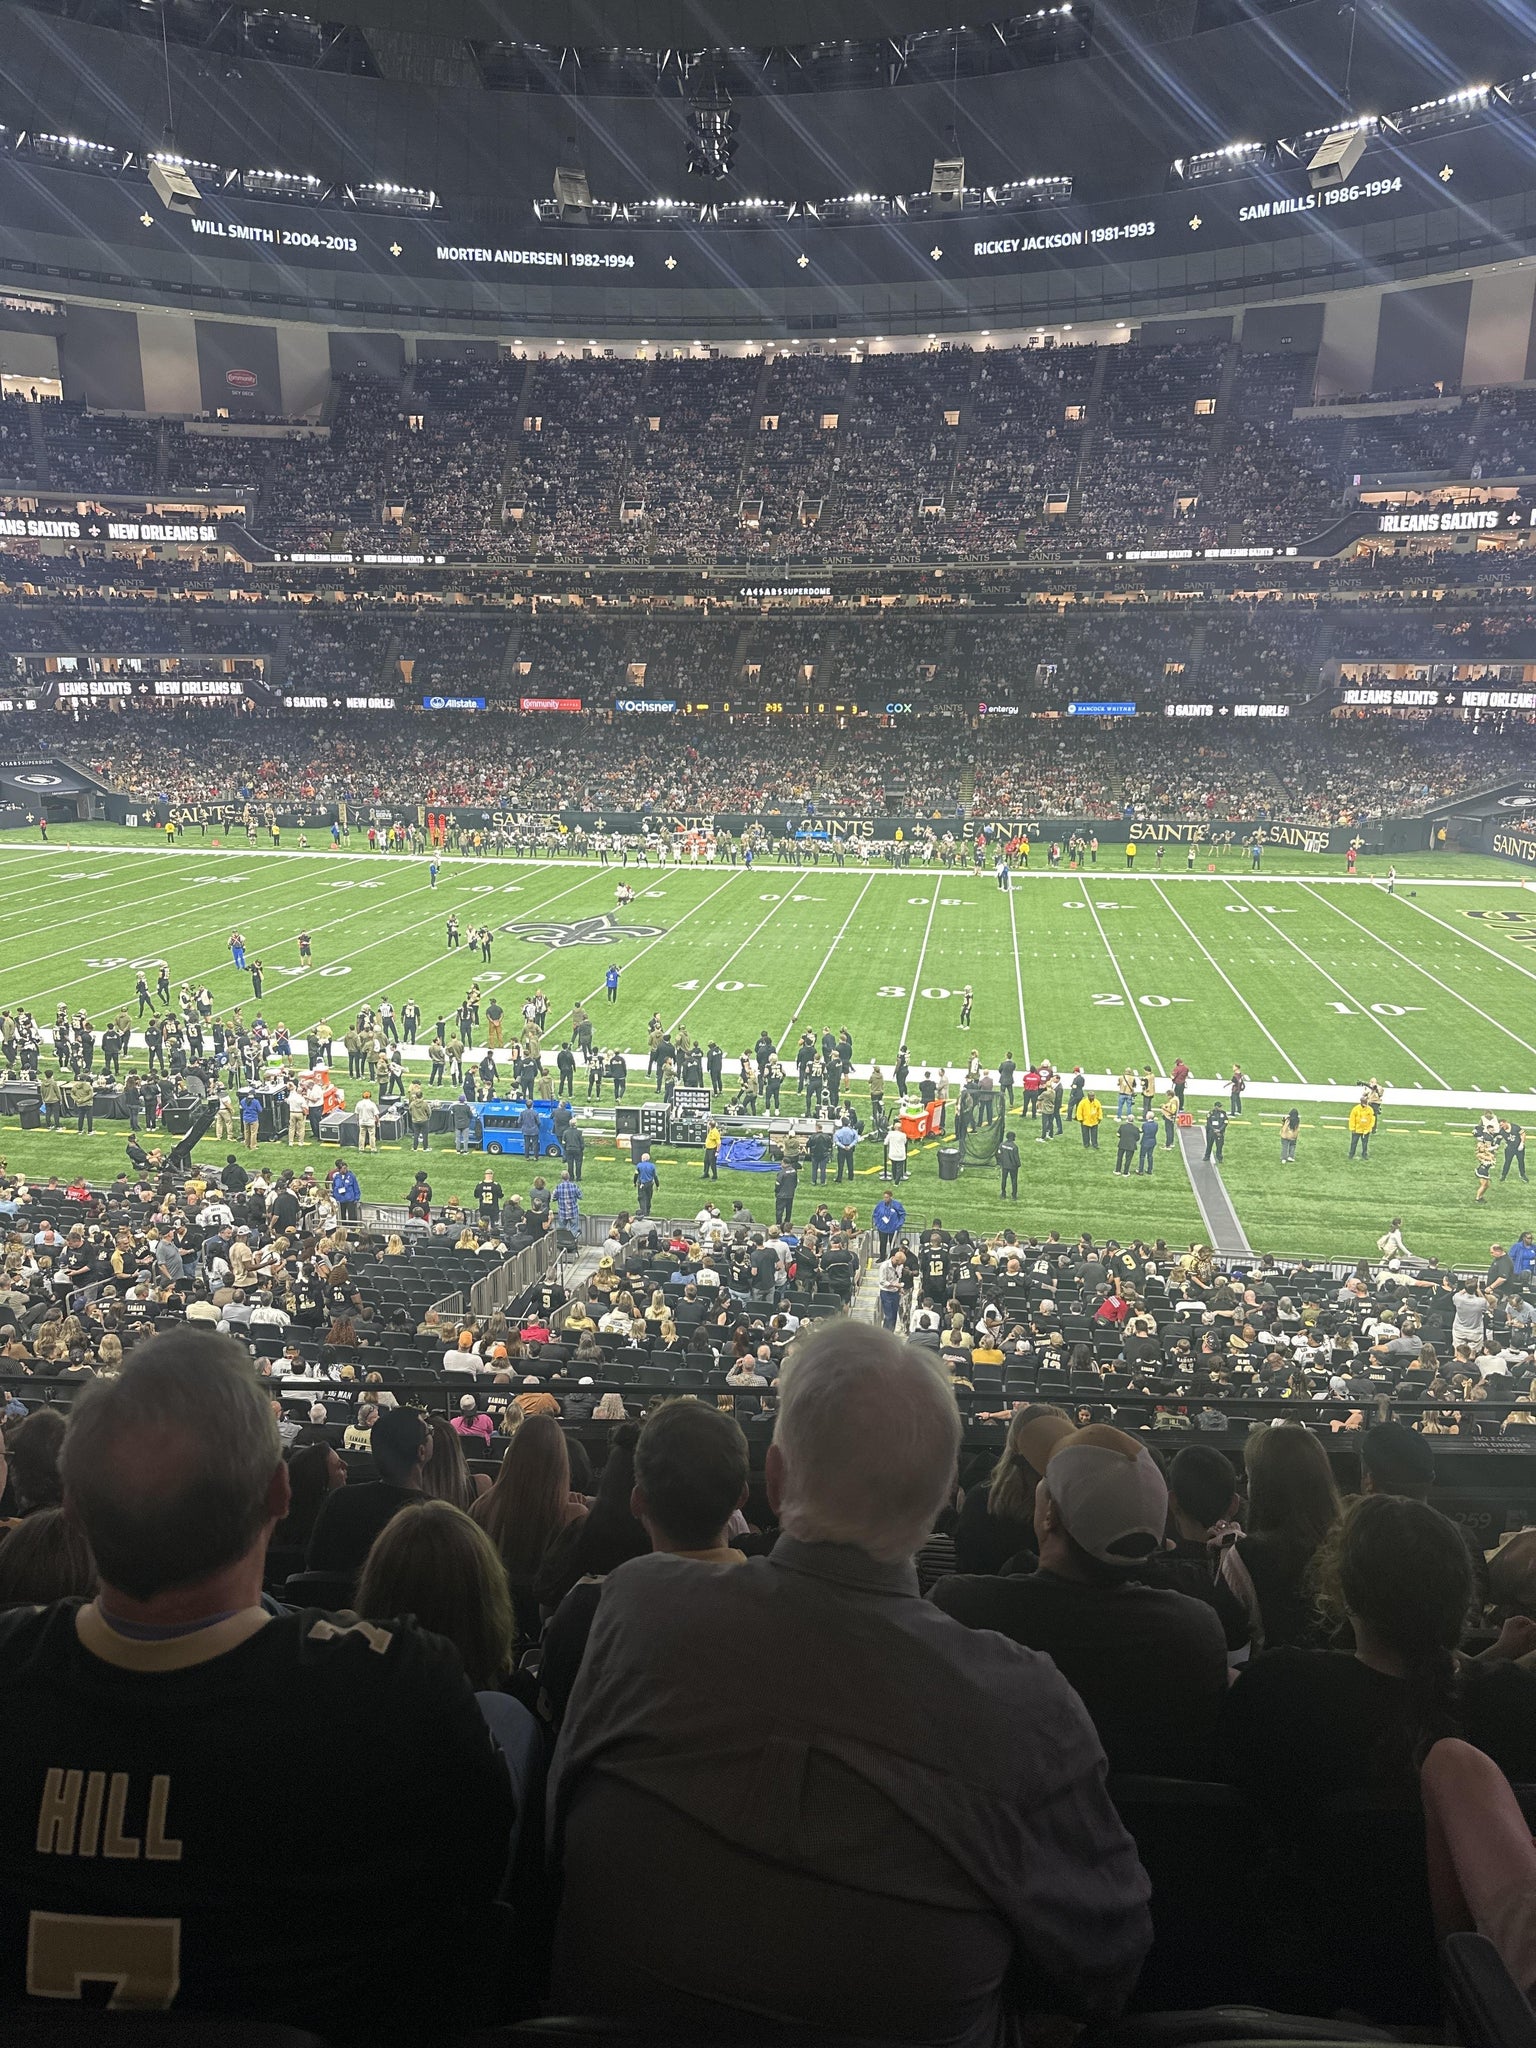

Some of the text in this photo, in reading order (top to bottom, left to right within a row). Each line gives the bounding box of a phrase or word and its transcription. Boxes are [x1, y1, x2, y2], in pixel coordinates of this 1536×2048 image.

[1239, 176, 1403, 222] SAM MILLS 1986-1994
[191, 218, 357, 251] WILL SMITH 2004-2013
[973, 221, 1156, 256] RICKEY JACKSON 1981-1993
[436, 246, 635, 268] MORTEN ANDERSEN 1982-1994
[1440, 510, 1500, 530] SAINTS
[27, 520, 81, 538] SAINTS
[108, 523, 139, 540] NEW
[141, 524, 200, 541] ORLEANS
[486, 555, 517, 564] SAINTS
[553, 556, 584, 565] SAINTS
[620, 556, 650, 565] SAINTS
[687, 556, 717, 565] SAINTS
[822, 556, 852, 565] SAINTS
[889, 555, 920, 564] SAINTS
[958, 554, 990, 562] SAINTS
[1028, 552, 1061, 561] SAINTS
[783, 587, 831, 595] SUPERDOME
[89, 681, 132, 696] SAINTS
[155, 681, 181, 695] NEW
[181, 681, 231, 695] ORLEANS
[293, 697, 328, 708] SAINTS
[346, 697, 368, 709] NEW
[488, 699, 518, 708] SAINTS
[523, 698, 559, 709] Community
[1393, 690, 1438, 705] SAINTS
[1462, 691, 1490, 706] NEW
[444, 699, 477, 709] Allstate
[625, 700, 674, 712] Ochsner
[886, 703, 912, 713] COX
[933, 704, 963, 712] SAINTS
[988, 704, 1019, 714] entergy
[1174, 704, 1213, 716] SAINTS
[1234, 704, 1258, 716] NEW
[1270, 824, 1330, 849] SAINTS
[471, 971, 546, 984] 50
[672, 979, 745, 992] 40
[876, 985, 951, 999] 30
[1091, 993, 1171, 1007] 20
[1325, 1001, 1406, 1016] 10
[1180, 1115, 1191, 1125] 20
[482, 1192, 493, 1204] 12
[929, 1260, 943, 1276] 12
[1033, 1259, 1049, 1275] 12
[1122, 1254, 1136, 1270] 9
[337, 1390, 353, 1400] MAN
[35, 1767, 183, 1861] HILL
[26, 1909, 181, 2011] 7
